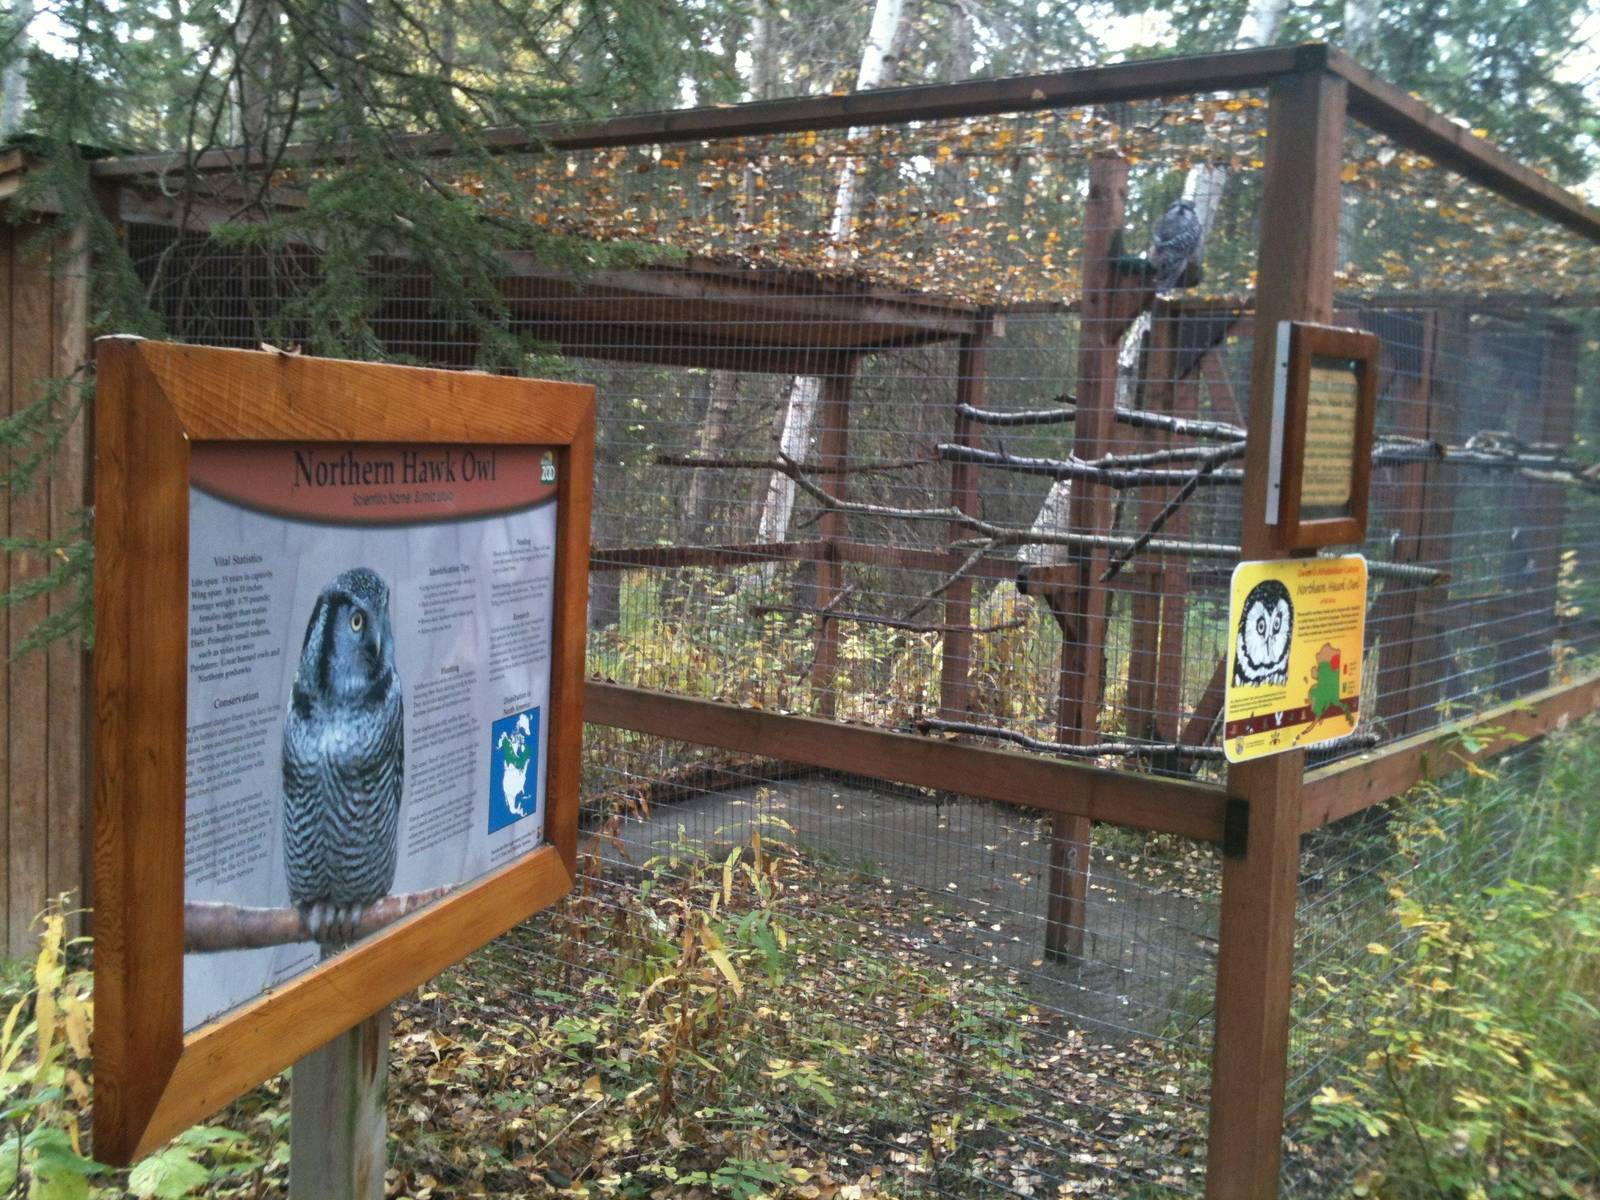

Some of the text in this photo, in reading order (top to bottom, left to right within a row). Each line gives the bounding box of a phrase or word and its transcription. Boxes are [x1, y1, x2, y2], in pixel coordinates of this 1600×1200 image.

[293, 450, 497, 487] Northern Hawk Owl
[213, 553, 264, 568] Vital Statistics
[1297, 580, 1326, 595] Northern
[213, 692, 259, 709] Conservation
